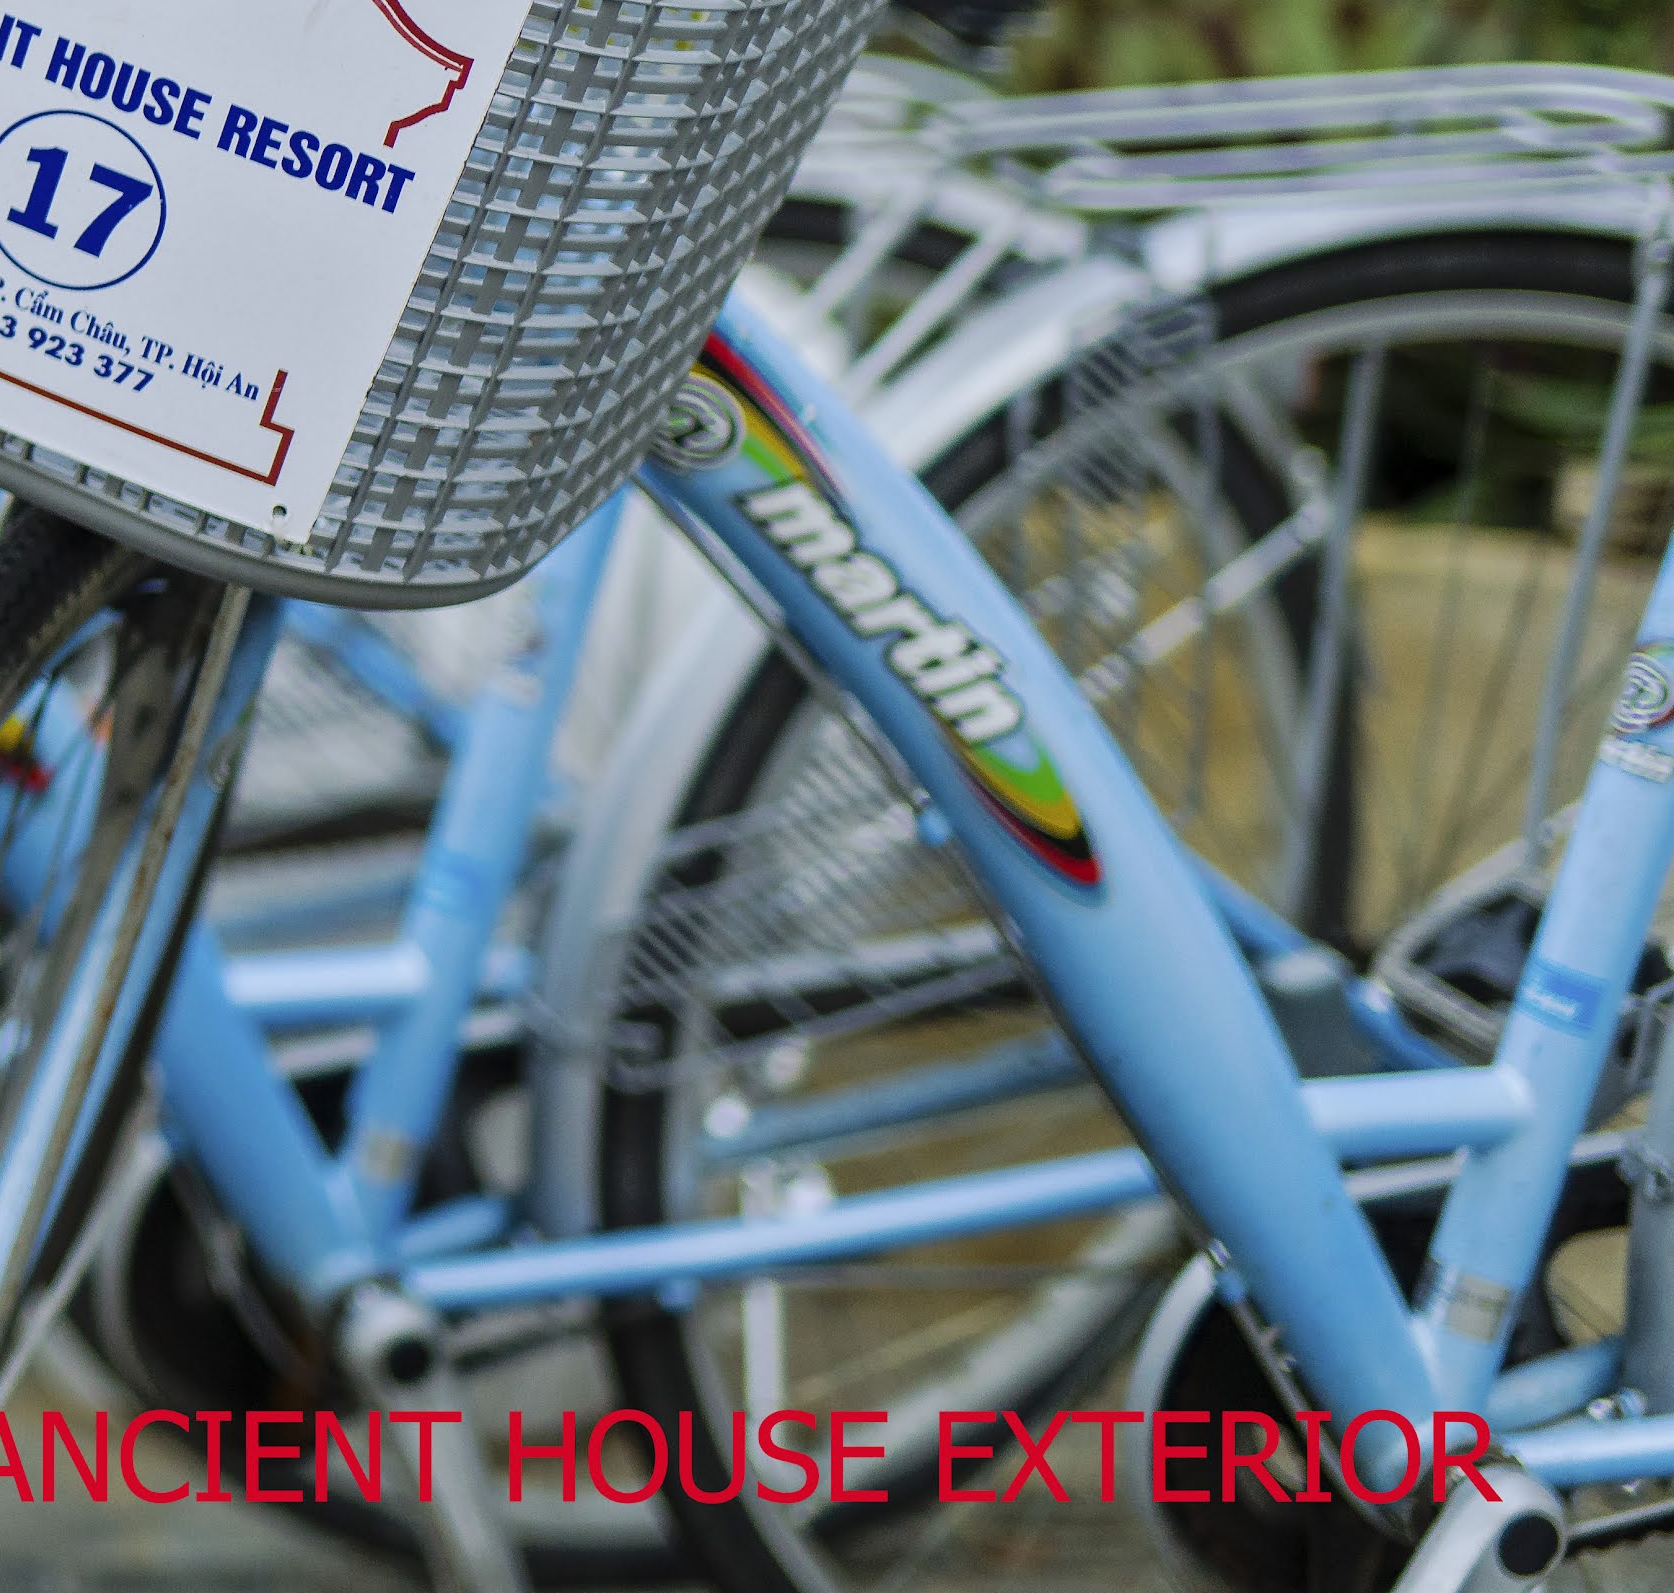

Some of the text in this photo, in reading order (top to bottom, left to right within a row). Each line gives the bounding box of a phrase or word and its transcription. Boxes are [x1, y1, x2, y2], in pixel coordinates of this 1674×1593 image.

[45, 36, 213, 140] HOUSE
[217, 104, 416, 215] RESORT
[7, 146, 154, 258] 17
[27, 327, 85, 367] 923
[93, 354, 155, 393] 377
[70, 309, 131, 356] Châu,
[141, 335, 175, 370] TP.
[181, 353, 224, 389] Hội
[225, 372, 260, 401] An
[739, 478, 1024, 746] martin
